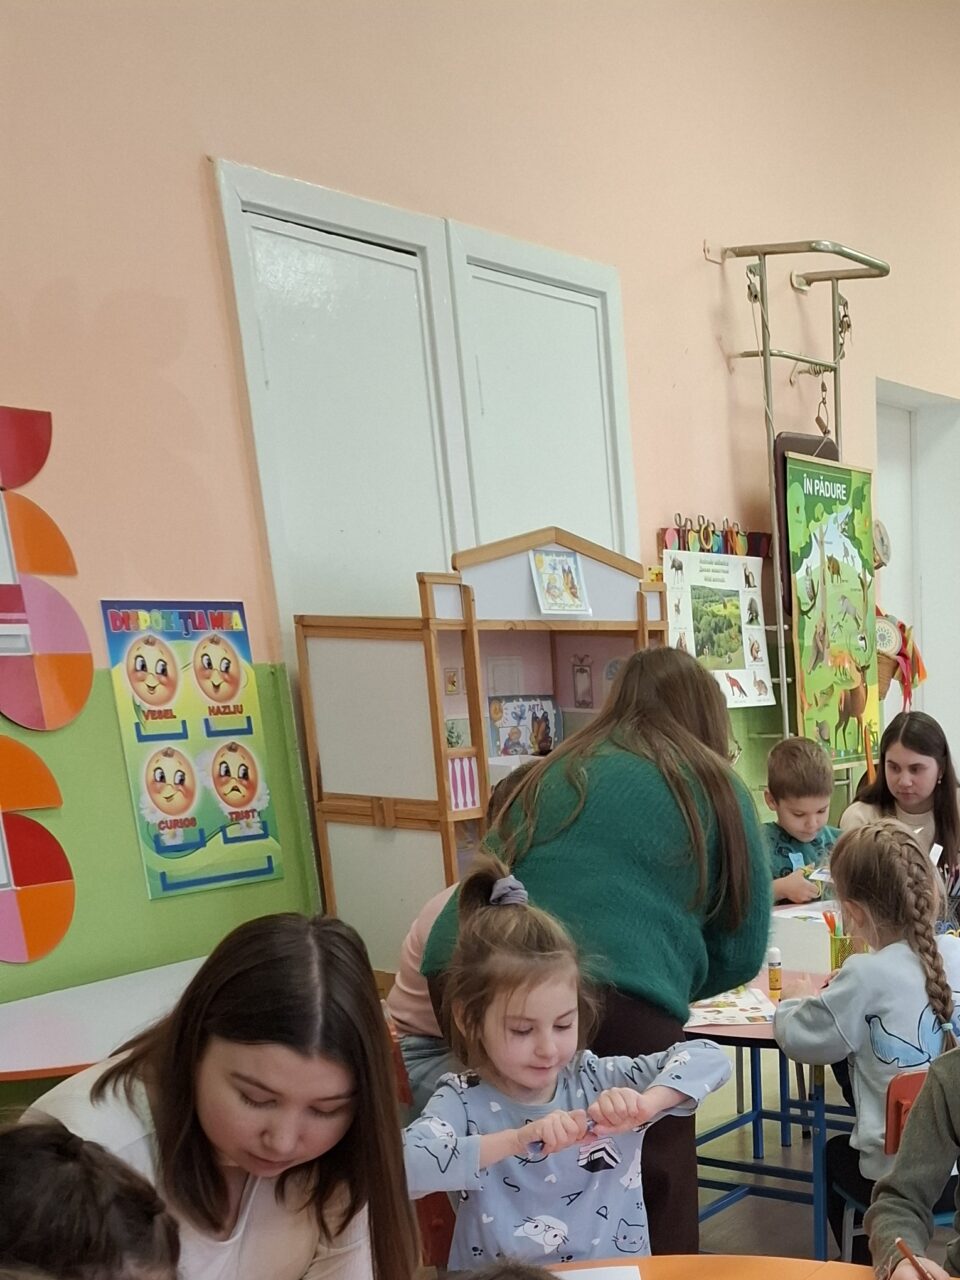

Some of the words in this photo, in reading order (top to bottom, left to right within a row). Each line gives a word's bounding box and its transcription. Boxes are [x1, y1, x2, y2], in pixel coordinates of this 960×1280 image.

[814, 476, 847, 500] PĂDURE
[142, 709, 177, 720] VESEL
[228, 809, 258, 822] TRIST
[157, 816, 197, 831] CURIOS
